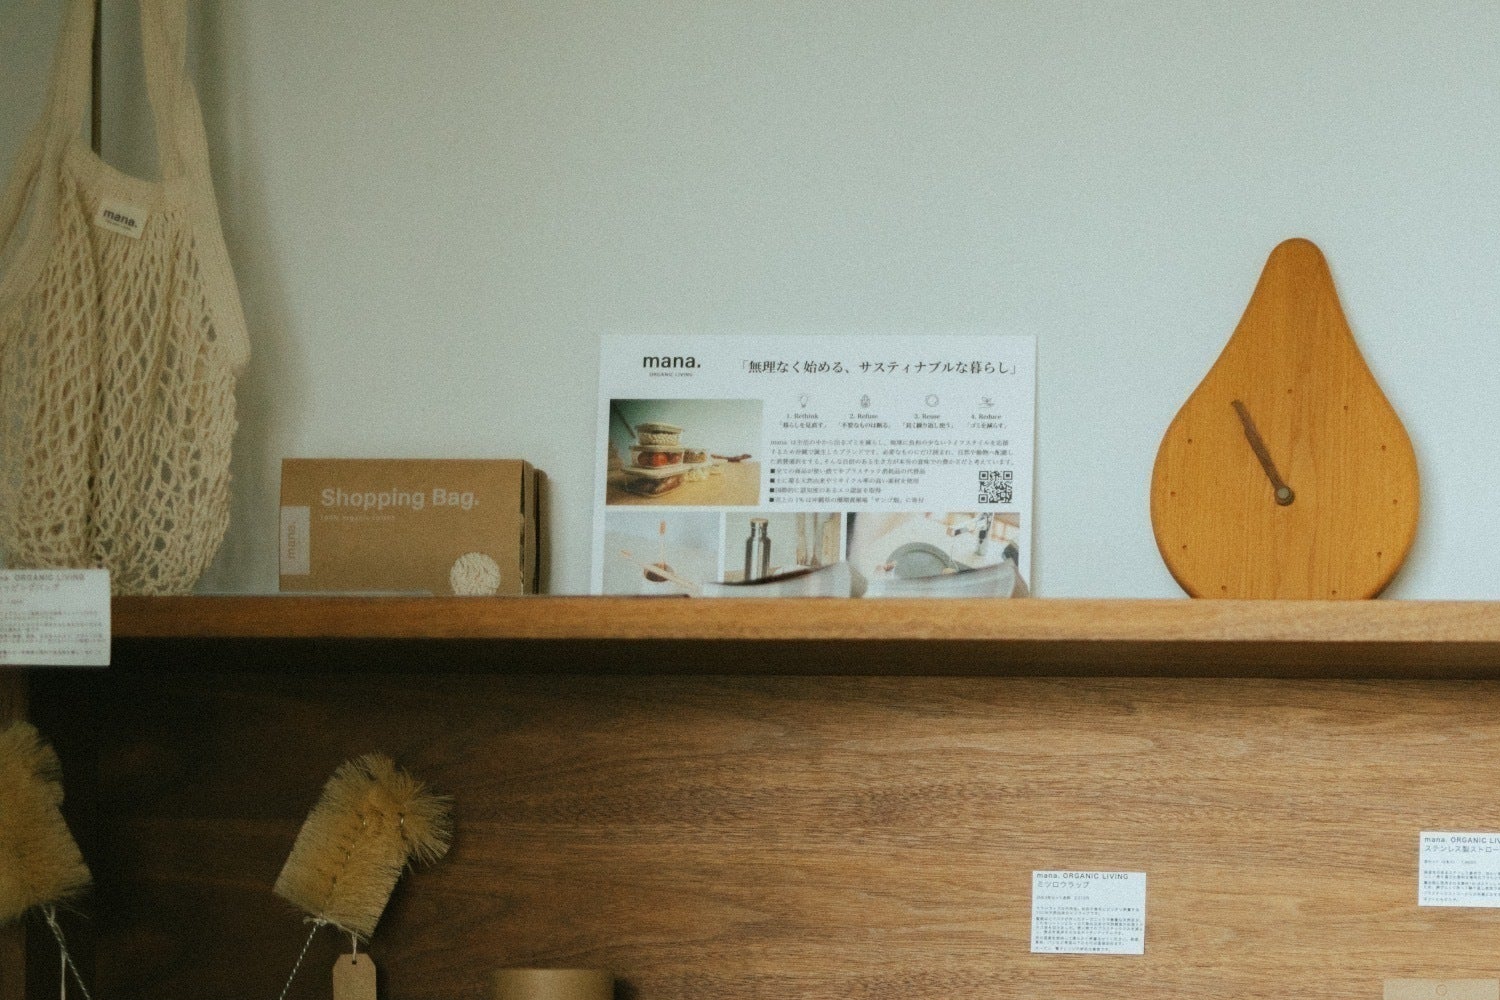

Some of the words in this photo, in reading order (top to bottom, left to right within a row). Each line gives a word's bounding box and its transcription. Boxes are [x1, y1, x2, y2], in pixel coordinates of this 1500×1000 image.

[103, 209, 137, 228] mana.
[643, 356, 701, 368] mana.
[321, 487, 425, 510] Shopping
[432, 488, 480, 510] Bag.
[1062, 872, 1100, 880] ORGANIC
